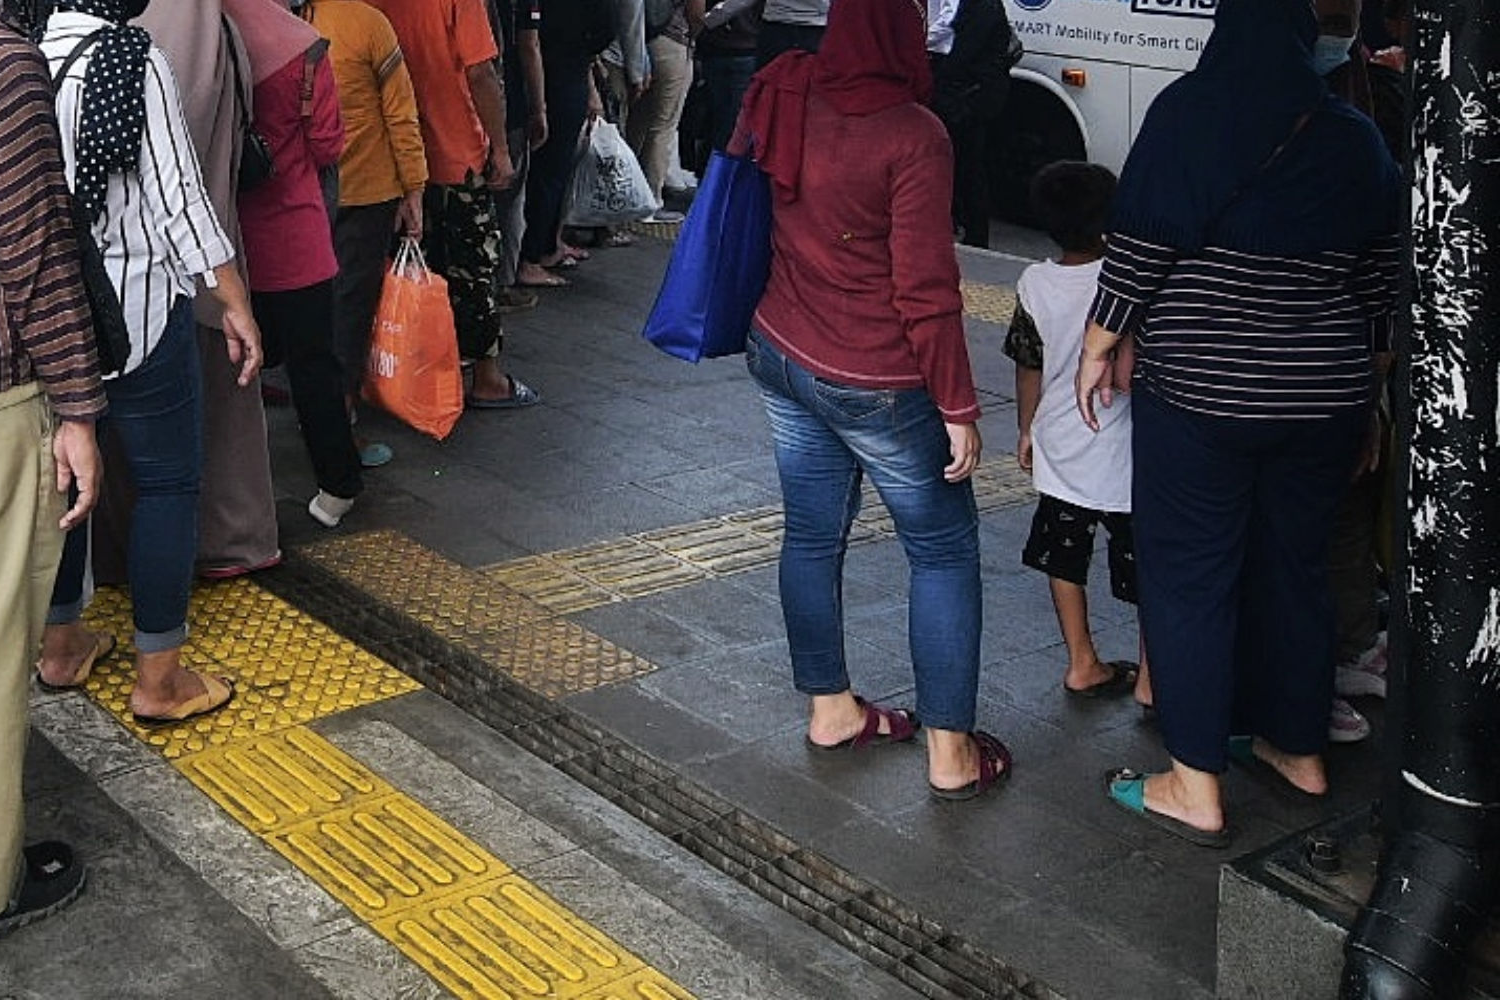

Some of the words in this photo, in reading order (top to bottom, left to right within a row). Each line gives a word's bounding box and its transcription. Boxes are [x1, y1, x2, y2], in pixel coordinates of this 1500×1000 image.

[1009, 20, 1052, 36] MART
[1055, 23, 1111, 44] Mobility
[1114, 30, 1133, 45] for
[1136, 33, 1180, 50] Smart
